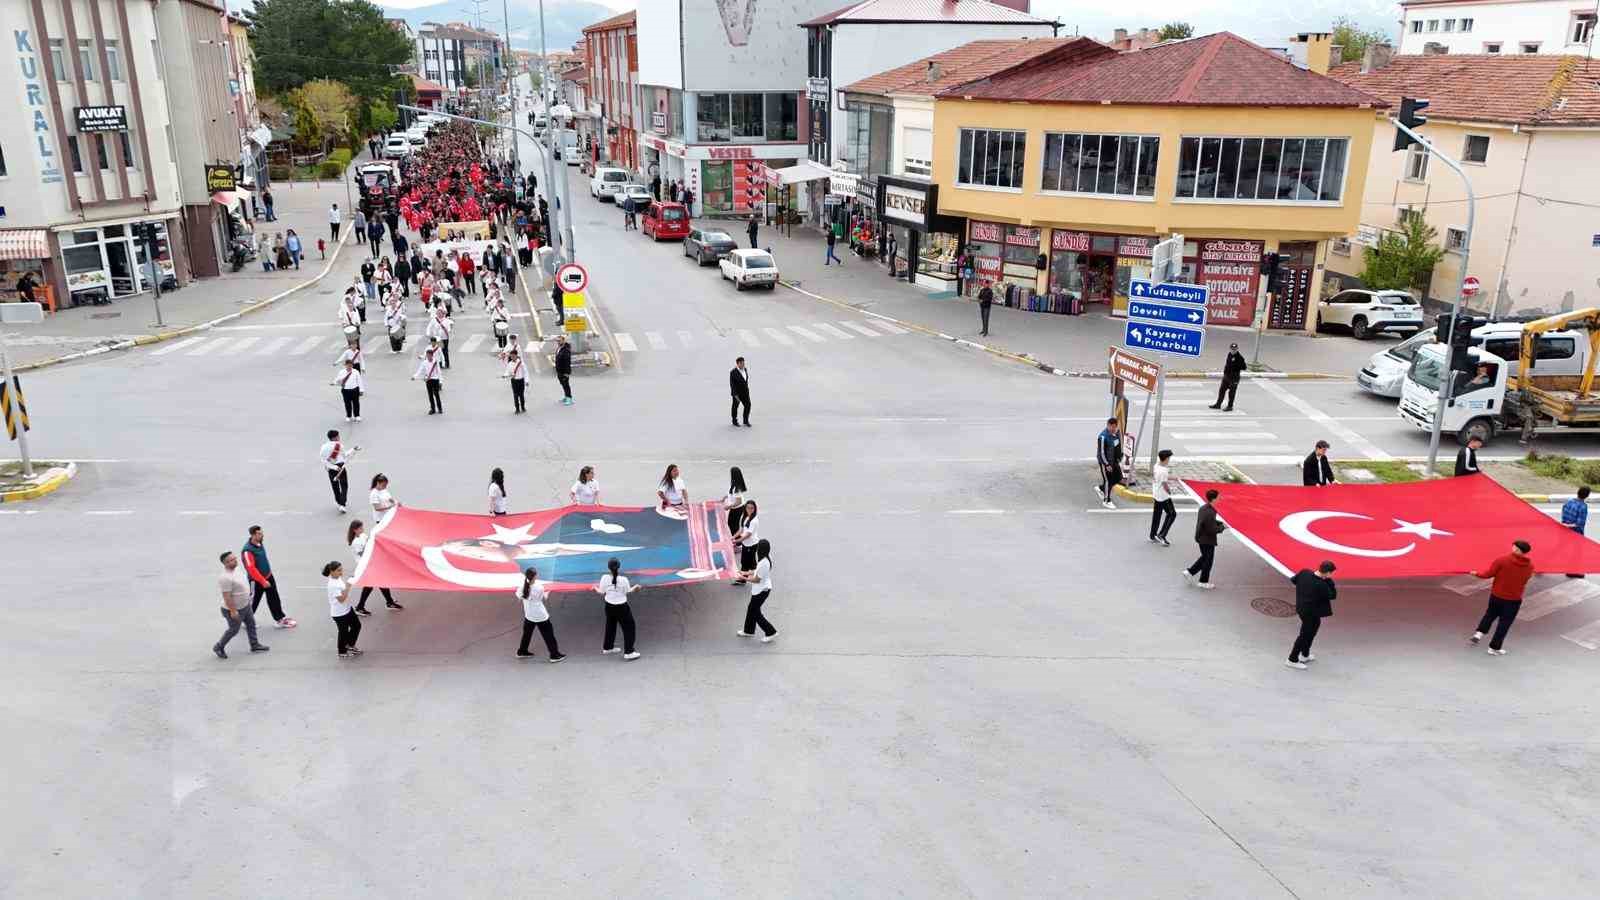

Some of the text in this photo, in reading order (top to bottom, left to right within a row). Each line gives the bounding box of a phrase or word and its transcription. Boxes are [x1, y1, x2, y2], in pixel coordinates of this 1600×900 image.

[79, 107, 123, 119] AVUKAT
[708, 148, 752, 158] VESTEL
[887, 193, 928, 214] KEVSER
[1052, 231, 1089, 250] GÜNDÜZ
[1205, 241, 1260, 252] GÜNDÜZ
[1204, 265, 1254, 275] KIRTASİYE
[1147, 286, 1201, 300] Tufanbeyli
[1132, 305, 1166, 317] Develi
[1211, 308, 1240, 319] VALİZ
[1145, 327, 1186, 341] Kayseri
